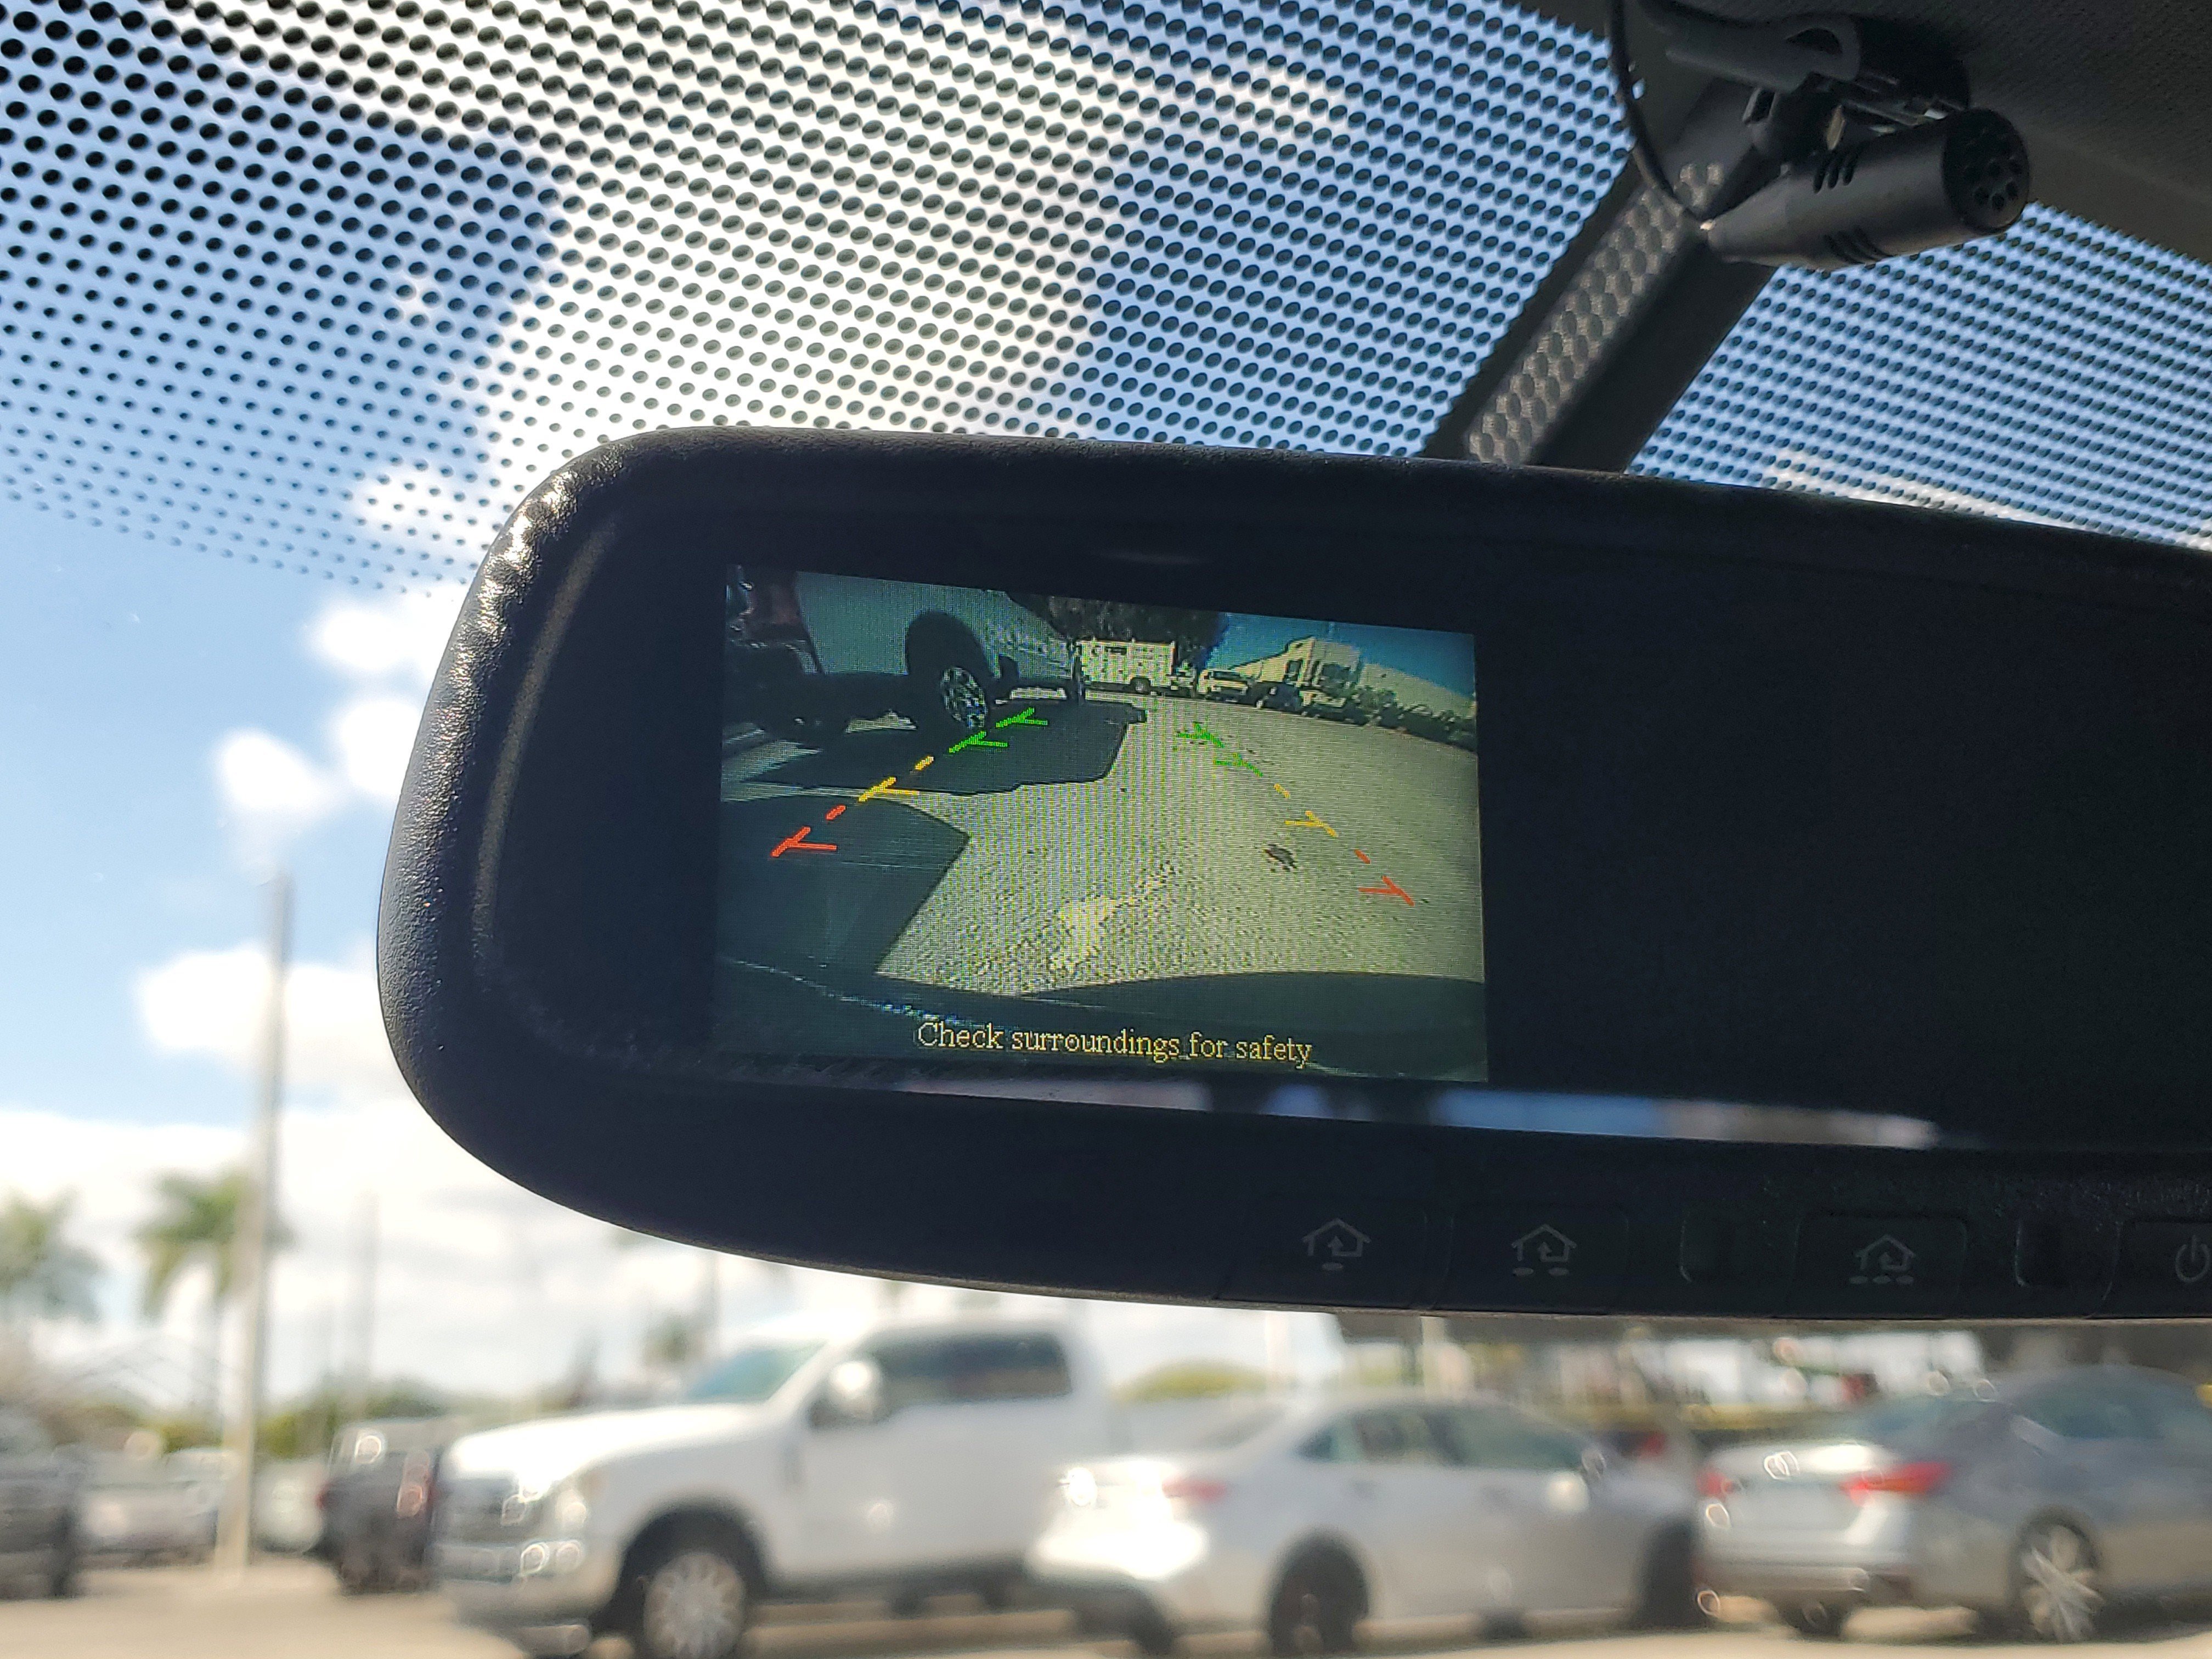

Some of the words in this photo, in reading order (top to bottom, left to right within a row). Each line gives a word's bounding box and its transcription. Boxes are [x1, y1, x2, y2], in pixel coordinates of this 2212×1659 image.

[917, 1022, 1003, 1050] Check
[1012, 1029, 1180, 1063] surroundings
[1189, 1031, 1227, 1059] for
[1235, 1035, 1312, 1069] safety
